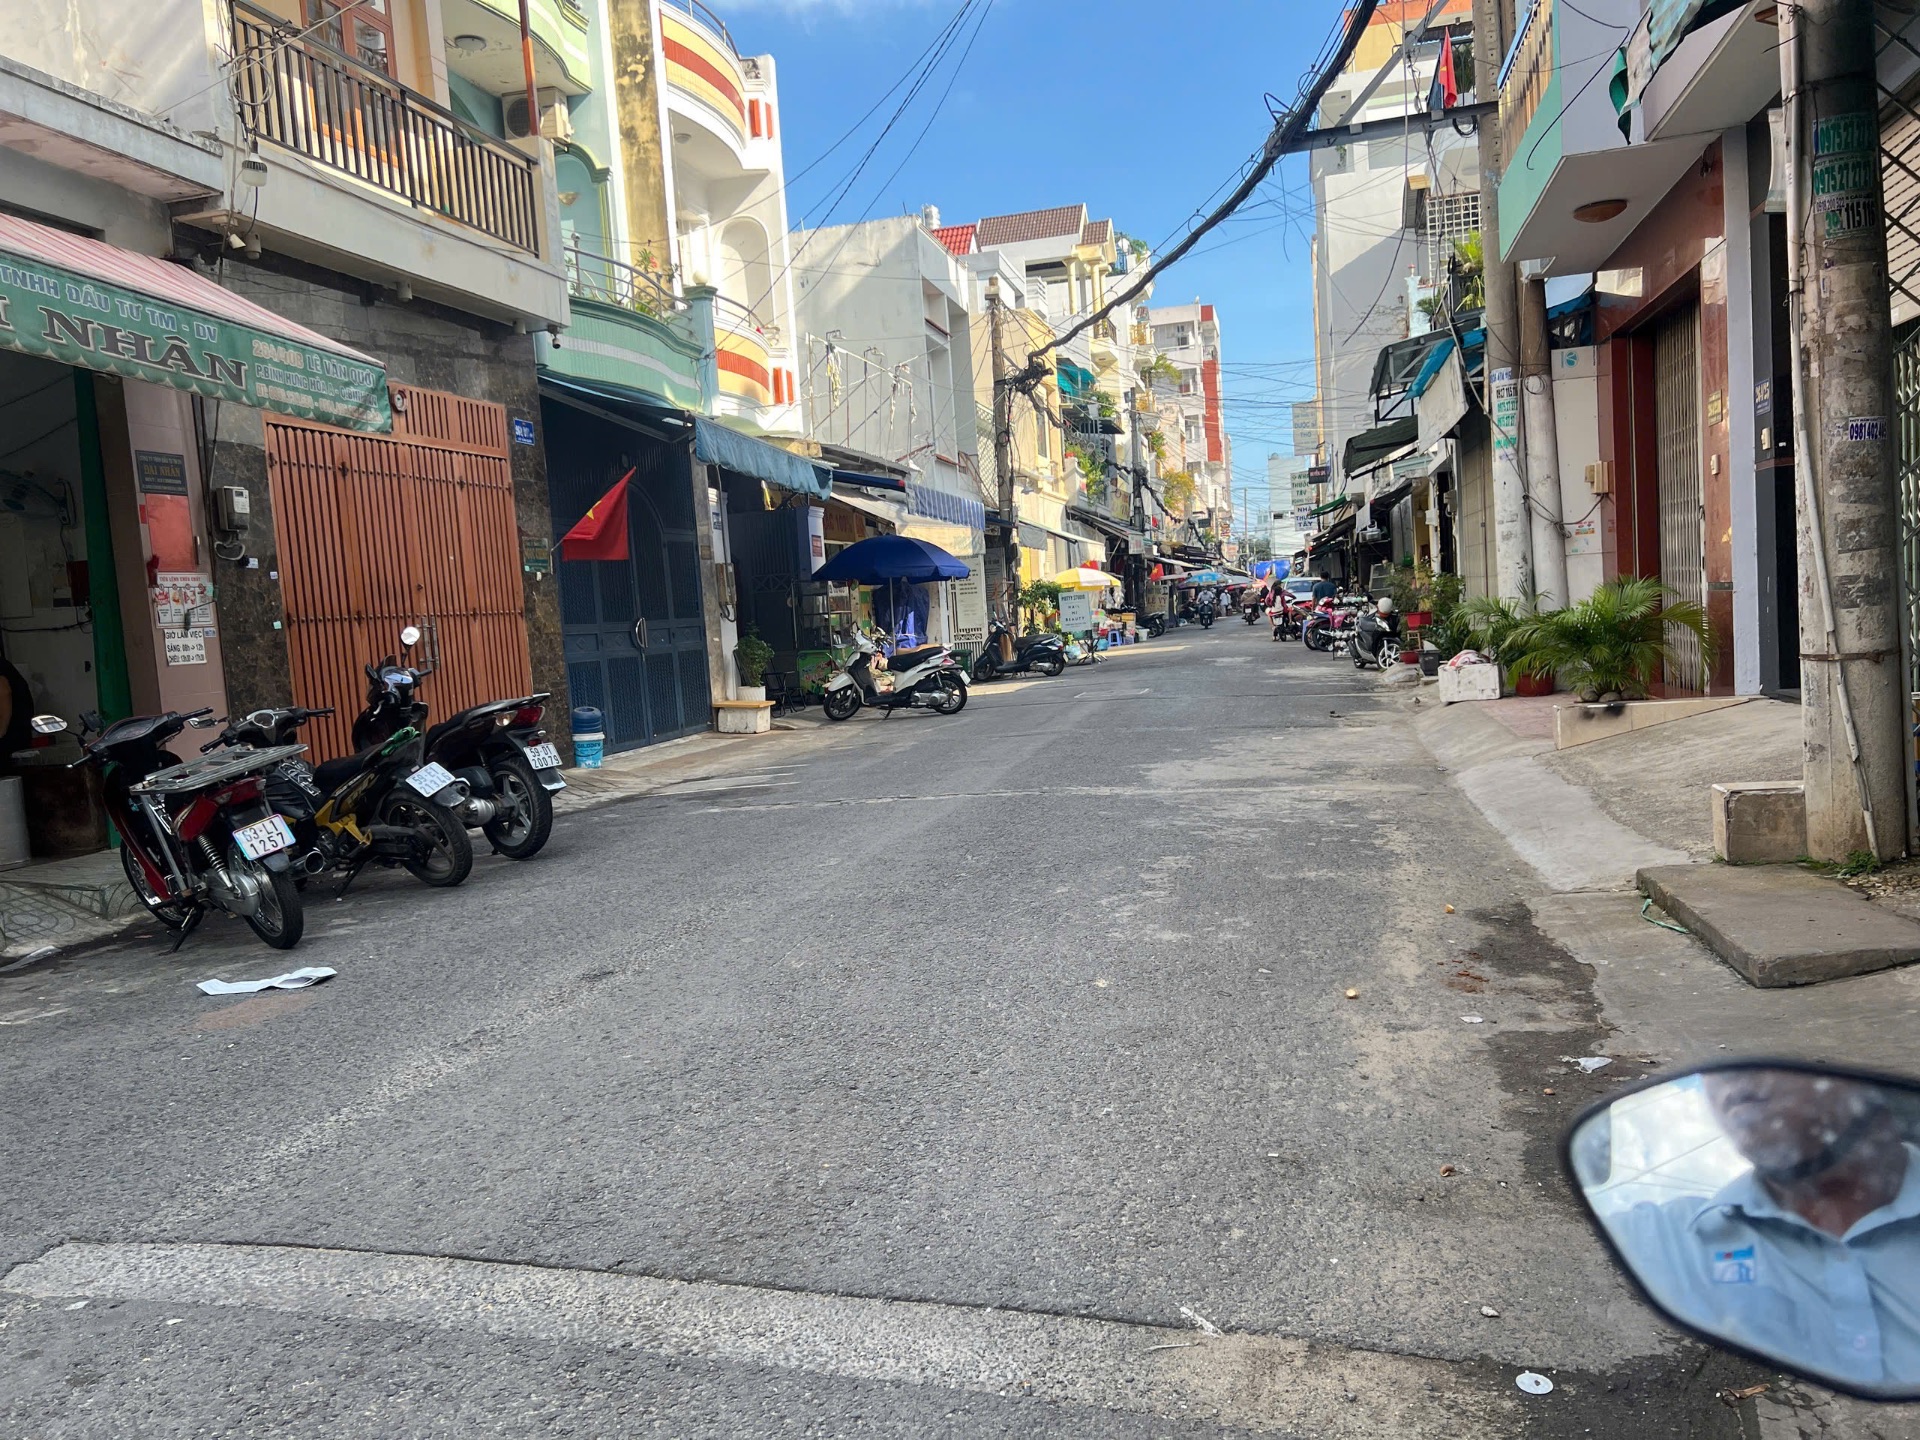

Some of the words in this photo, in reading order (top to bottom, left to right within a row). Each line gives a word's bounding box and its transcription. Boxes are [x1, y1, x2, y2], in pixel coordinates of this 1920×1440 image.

[0, 264, 60, 299] TNHH
[66, 284, 110, 312] ĐẦU
[114, 298, 142, 321] TƯ
[145, 307, 177, 332] TM
[194, 321, 218, 343] DV
[37, 305, 248, 391] NHÂN
[306, 354, 322, 374] LÊ
[323, 357, 349, 381] VĂN
[242, 820, 279, 842] 63-L1
[250, 831, 286, 855] 1257
